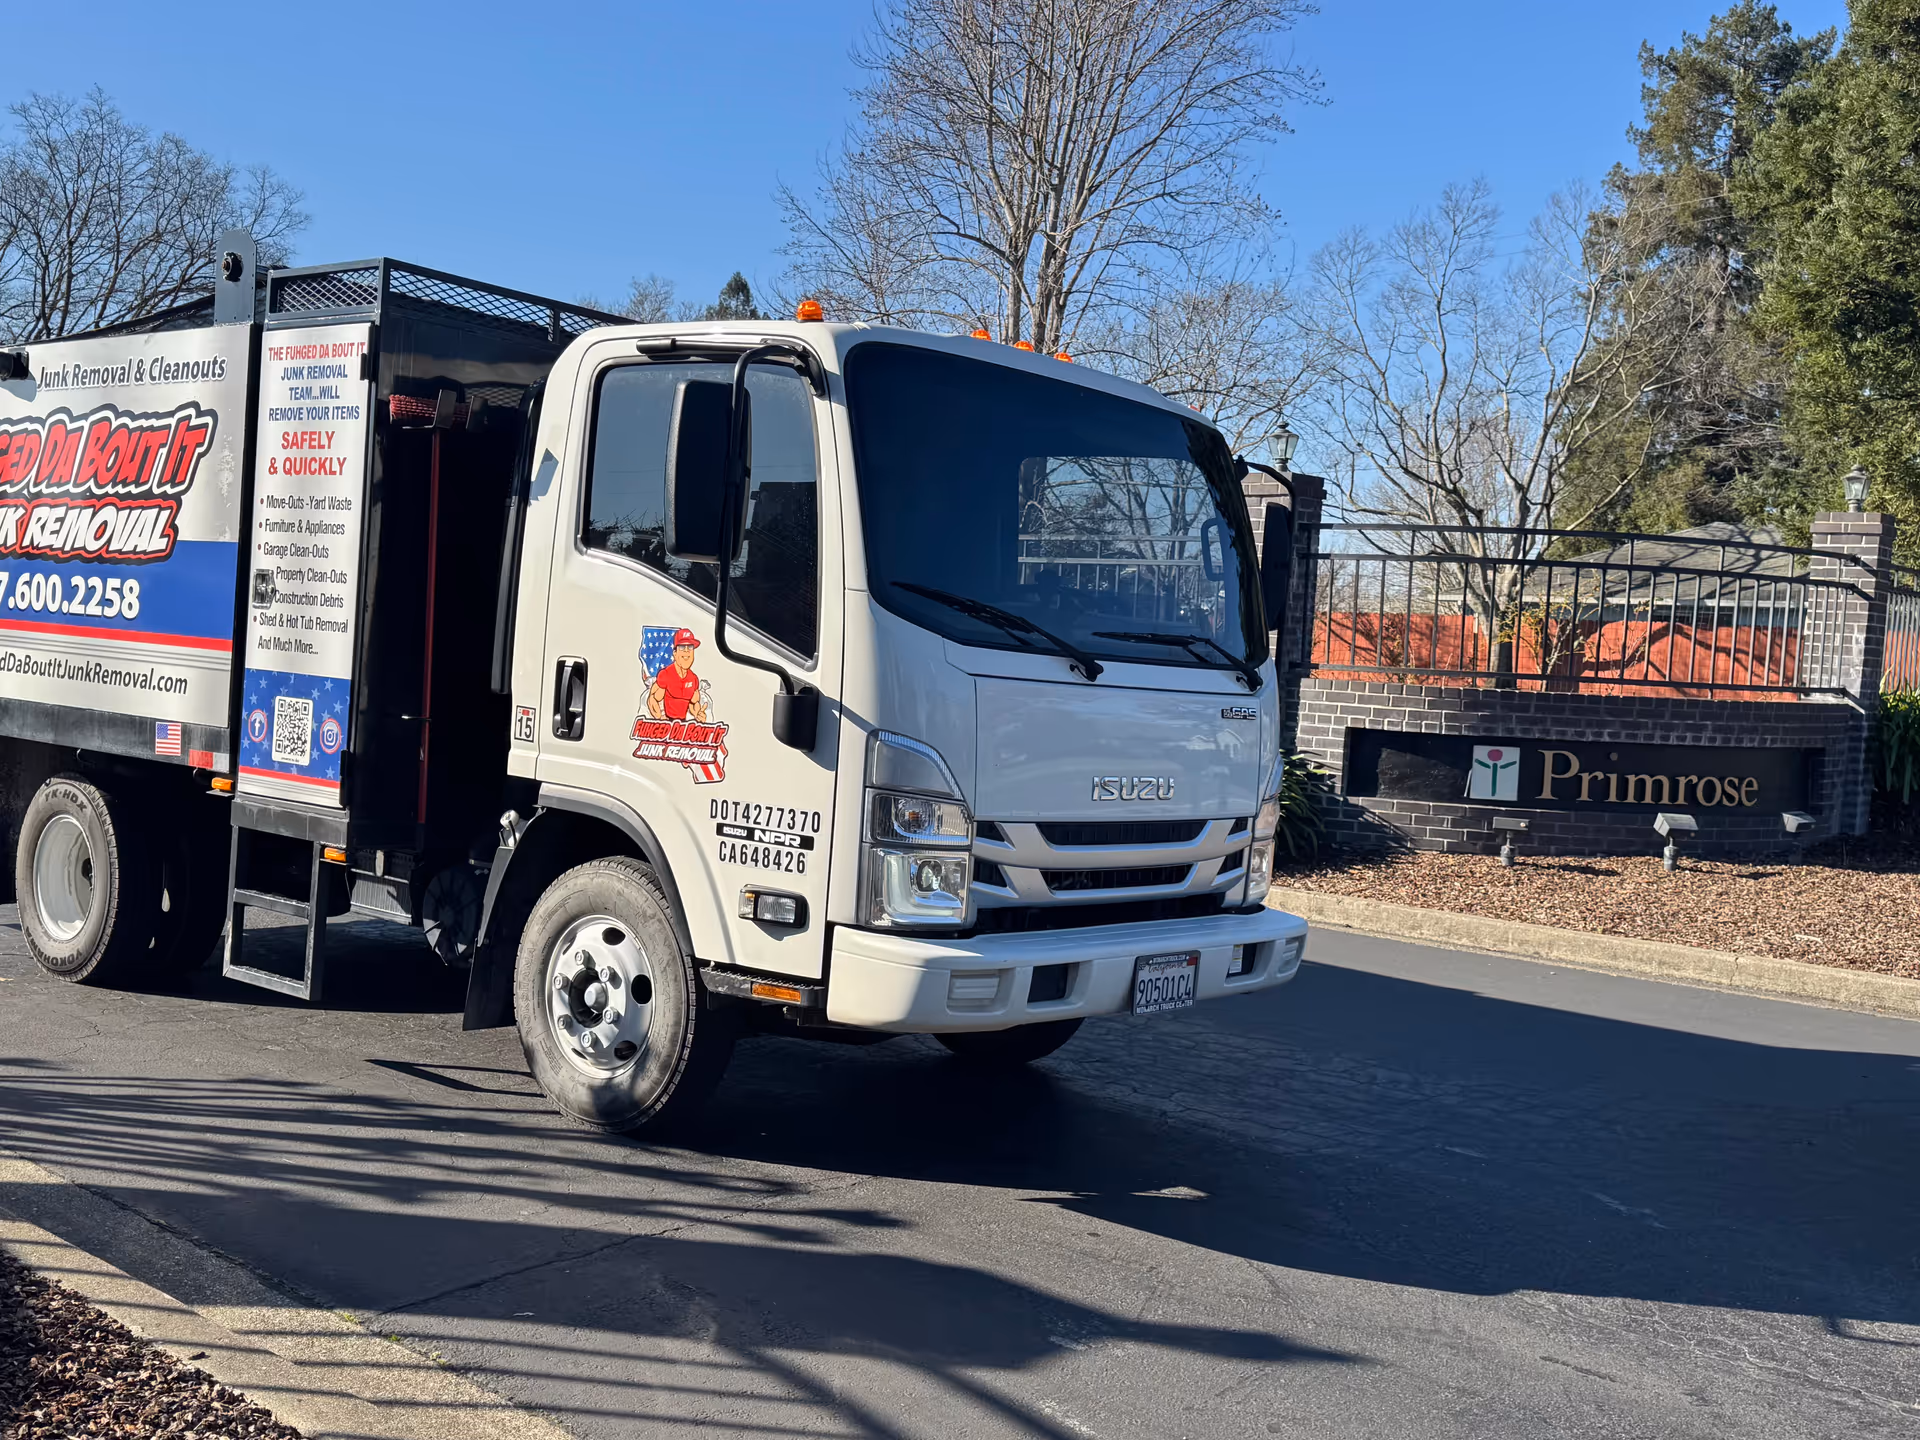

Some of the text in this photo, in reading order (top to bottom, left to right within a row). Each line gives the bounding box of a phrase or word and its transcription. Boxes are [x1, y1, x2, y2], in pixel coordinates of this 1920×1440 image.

[268, 342, 366, 361] THE FUHGED DA BOUT IT
[38, 355, 226, 389] Junk Removal & Cleanouts
[281, 364, 348, 381] JUNK REMOVAL
[268, 405, 360, 421] REMOVE YOUR ITEMS
[281, 431, 335, 450] SAFELY
[77, 420, 170, 485] BOUT
[161, 419, 208, 484] IT
[268, 457, 347, 477] & QUICKLY
[265, 495, 304, 510] Move-Outs
[328, 497, 352, 511] Waste
[22, 506, 171, 553] REMOVAL
[264, 518, 345, 537] Furniture & Appliances
[263, 542, 329, 559] Garage Clean-Outs
[276, 566, 348, 584] Property Clean-Outs
[274, 589, 344, 608] Construction Debris
[259, 612, 349, 633] Shed & Hot Tub Removal
[258, 635, 319, 655] And Much More...
[517, 716, 533, 739] 15
[683, 723, 714, 743] BOUT
[711, 725, 726, 743] IT
[637, 744, 716, 761] JUNK REMOVAL
[1534, 749, 1759, 807] Primrose
[1092, 776, 1175, 801] ISUZU
[710, 799, 821, 833] DOT4277370
[723, 826, 801, 847] ISUZU NPR
[719, 841, 806, 874] CA648426
[26, 926, 83, 967] YOKOHAMA
[1136, 973, 1191, 1005] 90501C4
[1160, 1001, 1175, 1010] TRUCK
